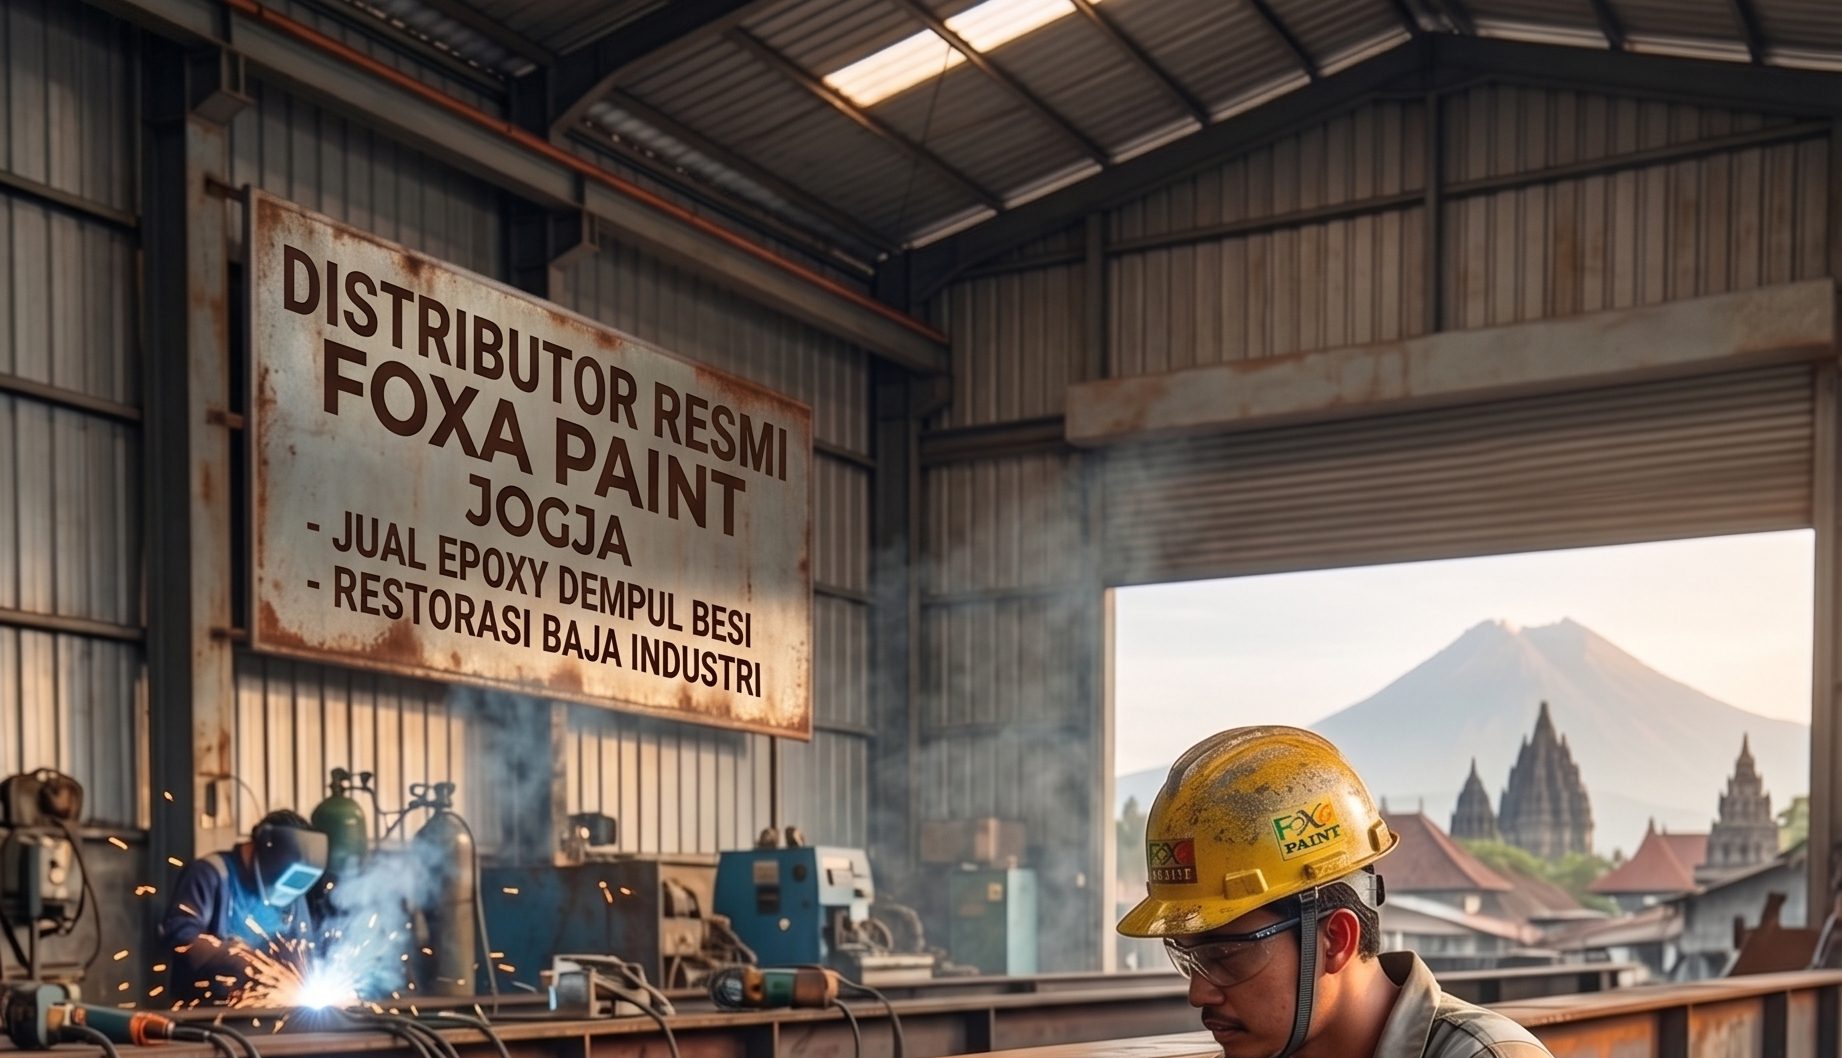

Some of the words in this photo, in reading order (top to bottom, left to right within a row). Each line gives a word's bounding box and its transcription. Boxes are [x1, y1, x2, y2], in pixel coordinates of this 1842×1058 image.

[283, 244, 638, 430] DISTRIBUTOR
[654, 382, 788, 481] RESMI
[323, 338, 533, 476] FOXA
[555, 417, 746, 537] PAINT
[332, 510, 426, 570] JUAL
[439, 536, 548, 598] EPOXY
[560, 566, 682, 632] DEMPUL
[692, 600, 752, 648] BESI
[465, 473, 632, 567] JOGJA
[334, 565, 531, 647] RESTORASI
[543, 614, 622, 667] BAJA
[632, 635, 762, 698] INDUSTRI
[1284, 824, 1340, 854] PAINT
